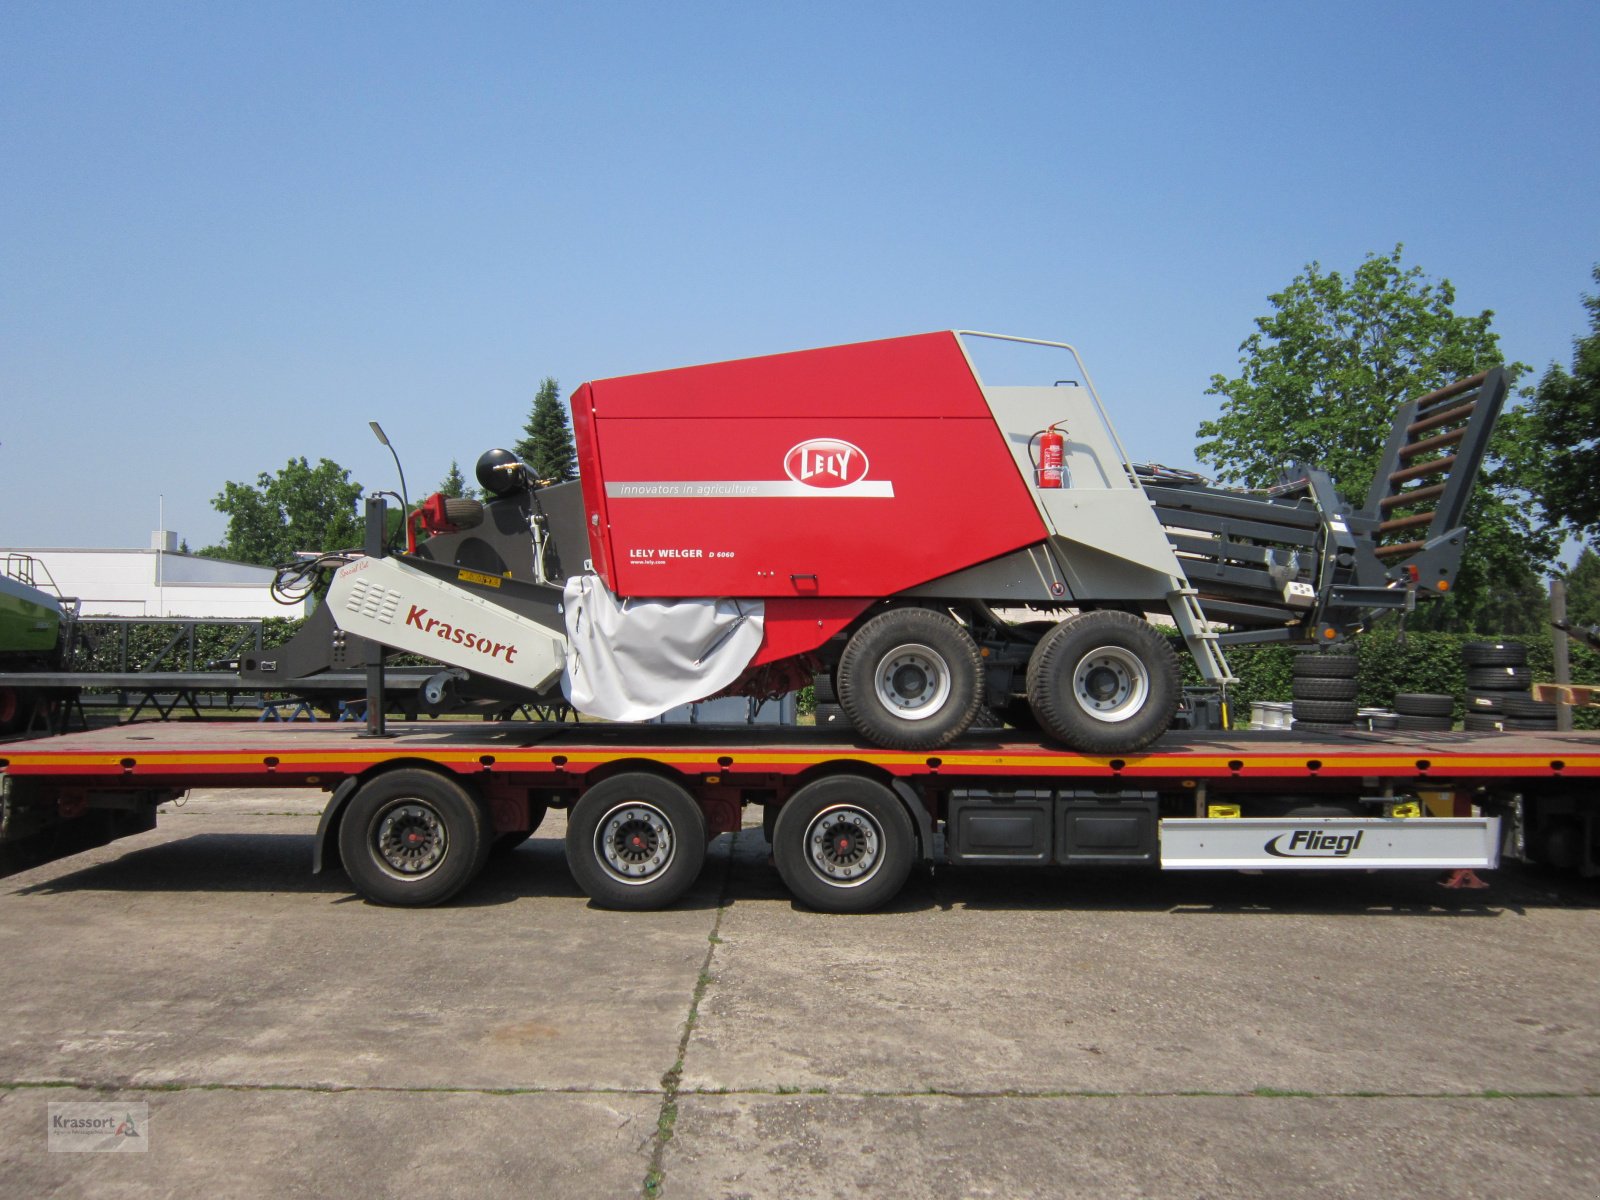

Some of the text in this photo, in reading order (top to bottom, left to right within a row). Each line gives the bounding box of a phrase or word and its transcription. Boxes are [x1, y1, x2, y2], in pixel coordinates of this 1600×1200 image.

[801, 447, 851, 481] LELY
[620, 483, 758, 496] innovators in agriculture
[630, 549, 655, 558] LELY
[658, 549, 703, 558] WELGER
[405, 604, 518, 664] Krassort
[1289, 830, 1364, 854] Fliegl
